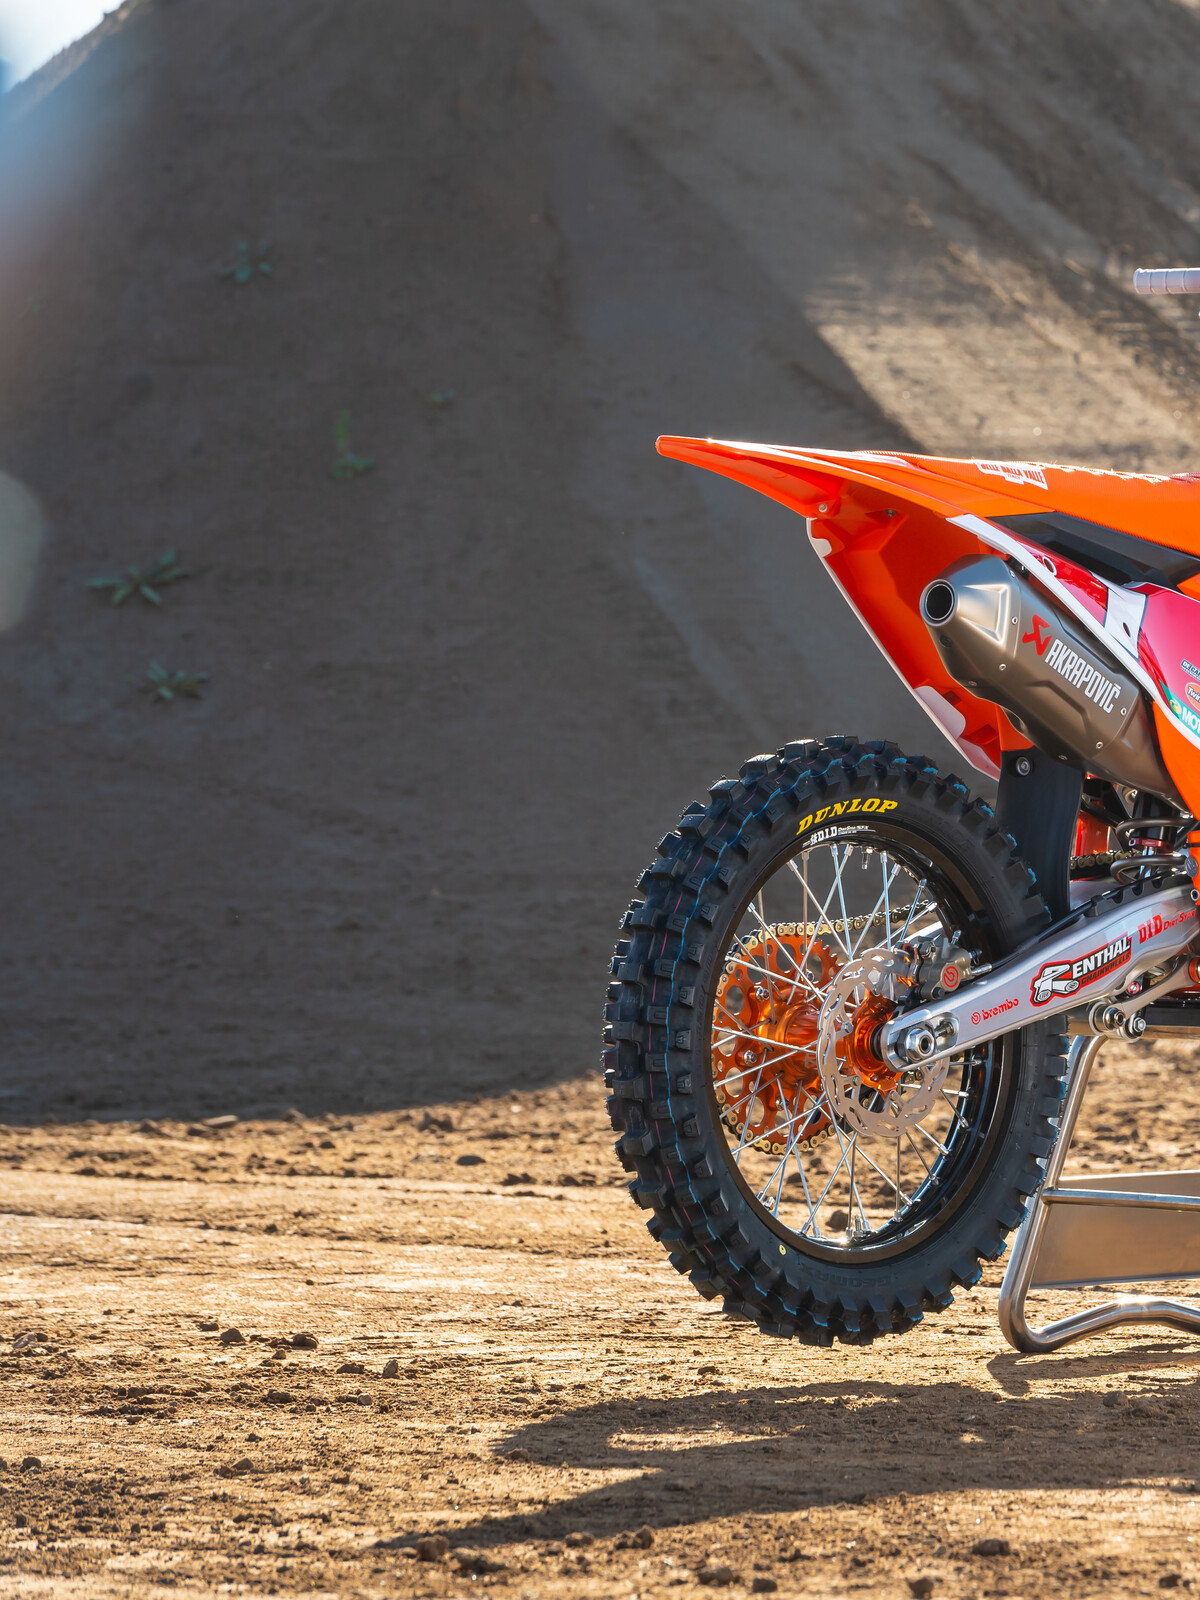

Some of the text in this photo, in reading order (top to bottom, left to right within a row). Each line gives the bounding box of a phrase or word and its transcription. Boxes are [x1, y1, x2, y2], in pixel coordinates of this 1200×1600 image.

[796, 798, 898, 835] DUNLOP
[1081, 951, 1130, 984] CHAINWHEELS
[982, 998, 1019, 1020] brembo
